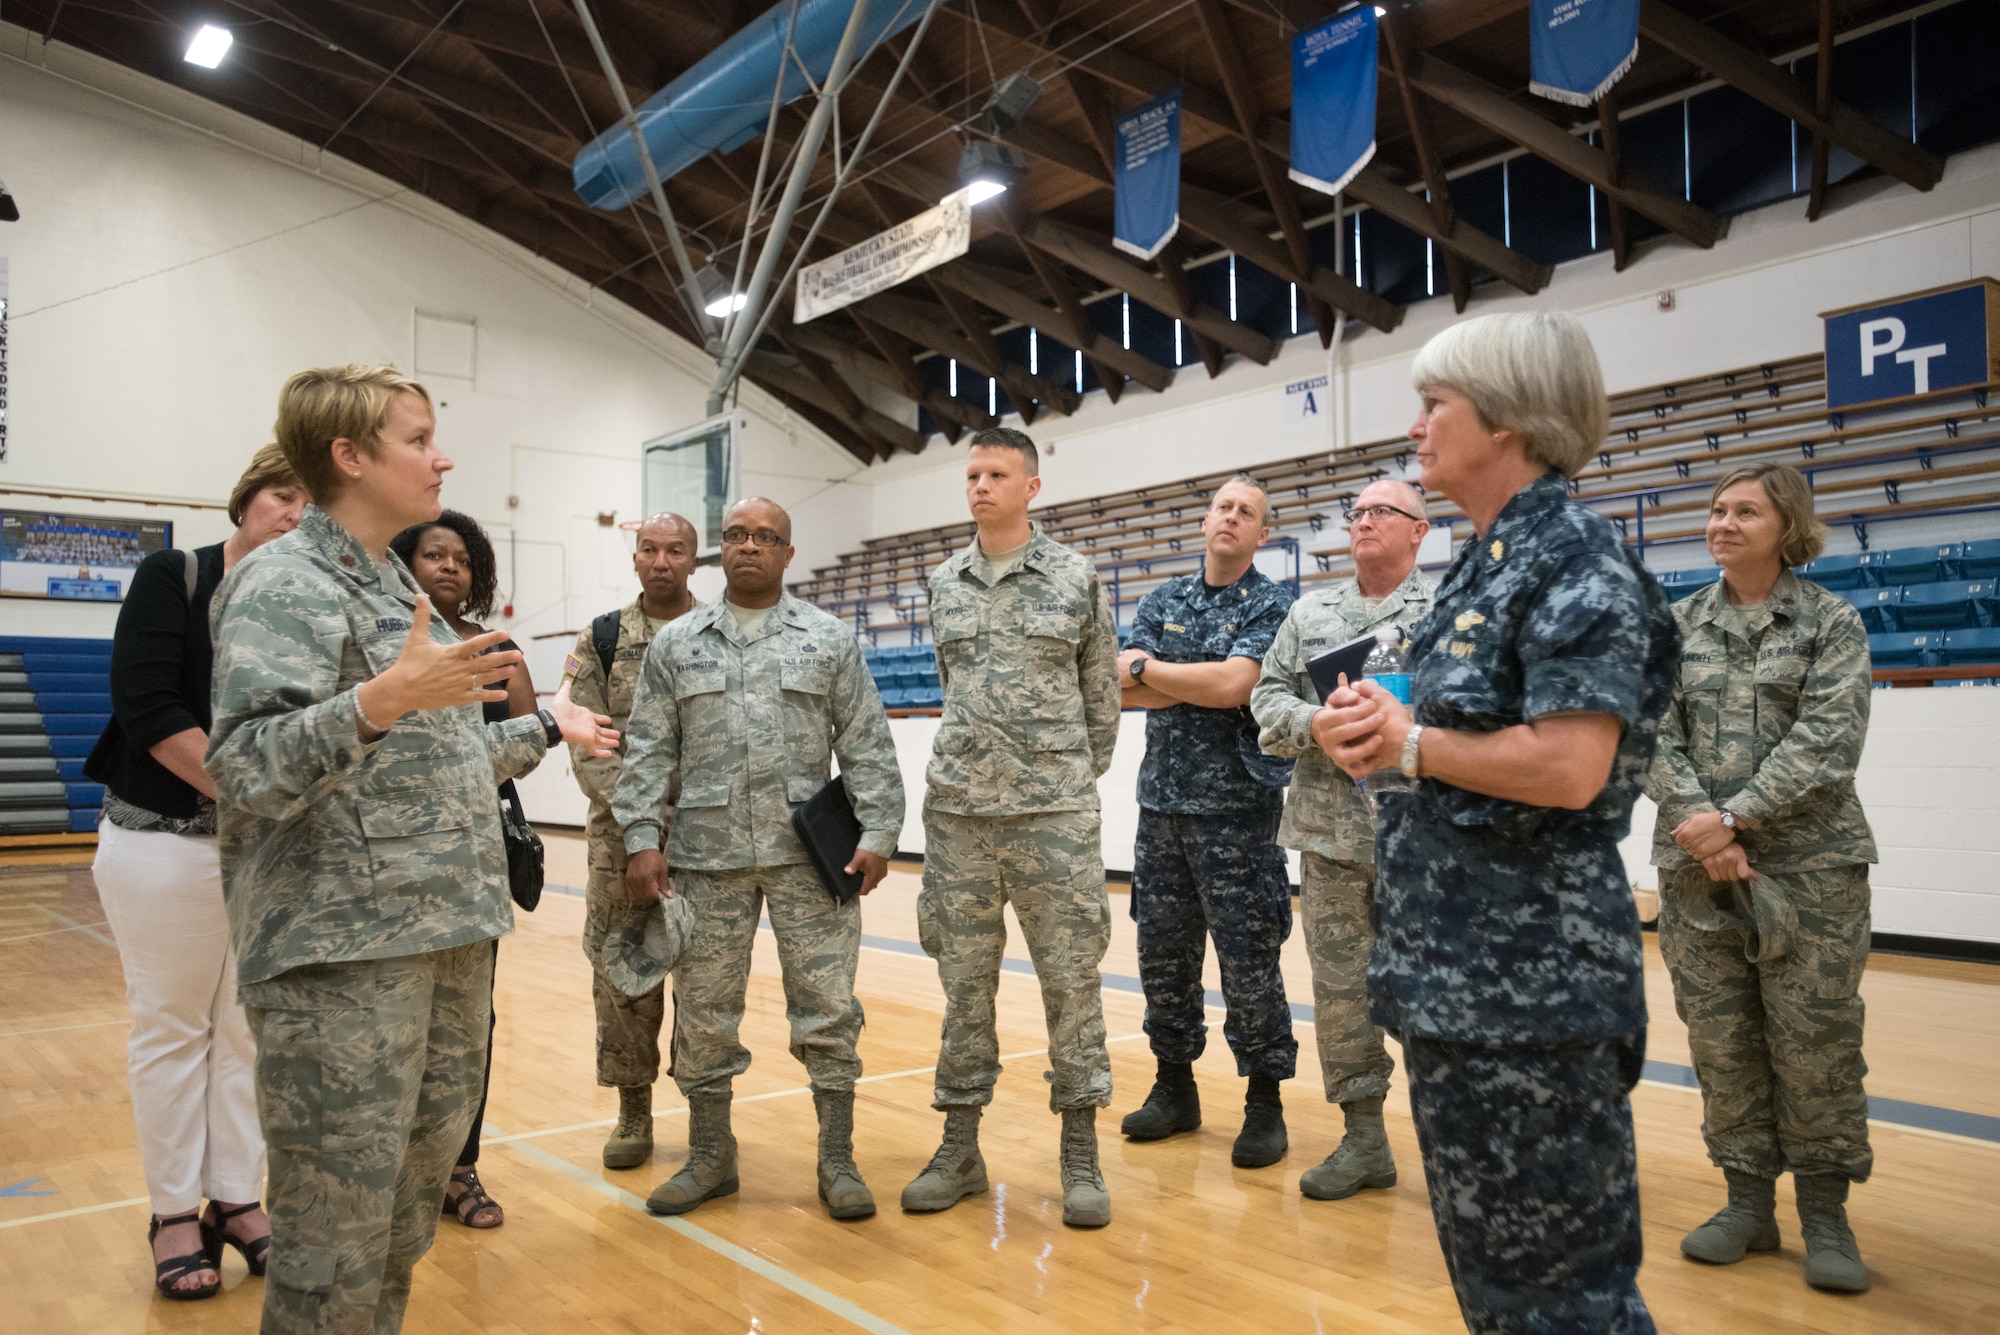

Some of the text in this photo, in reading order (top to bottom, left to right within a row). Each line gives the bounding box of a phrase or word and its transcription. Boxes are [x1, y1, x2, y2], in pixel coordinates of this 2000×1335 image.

[1859, 316, 1947, 395] PT
[1303, 391, 1318, 416] A
[1046, 604, 1058, 612] AIR
[1302, 637, 1327, 648] THIGPEN
[1776, 646, 1791, 657] AIR
[676, 660, 718, 673] WASHINGTON
[798, 658, 812, 666] AIR
[812, 658, 832, 670] FORCE
